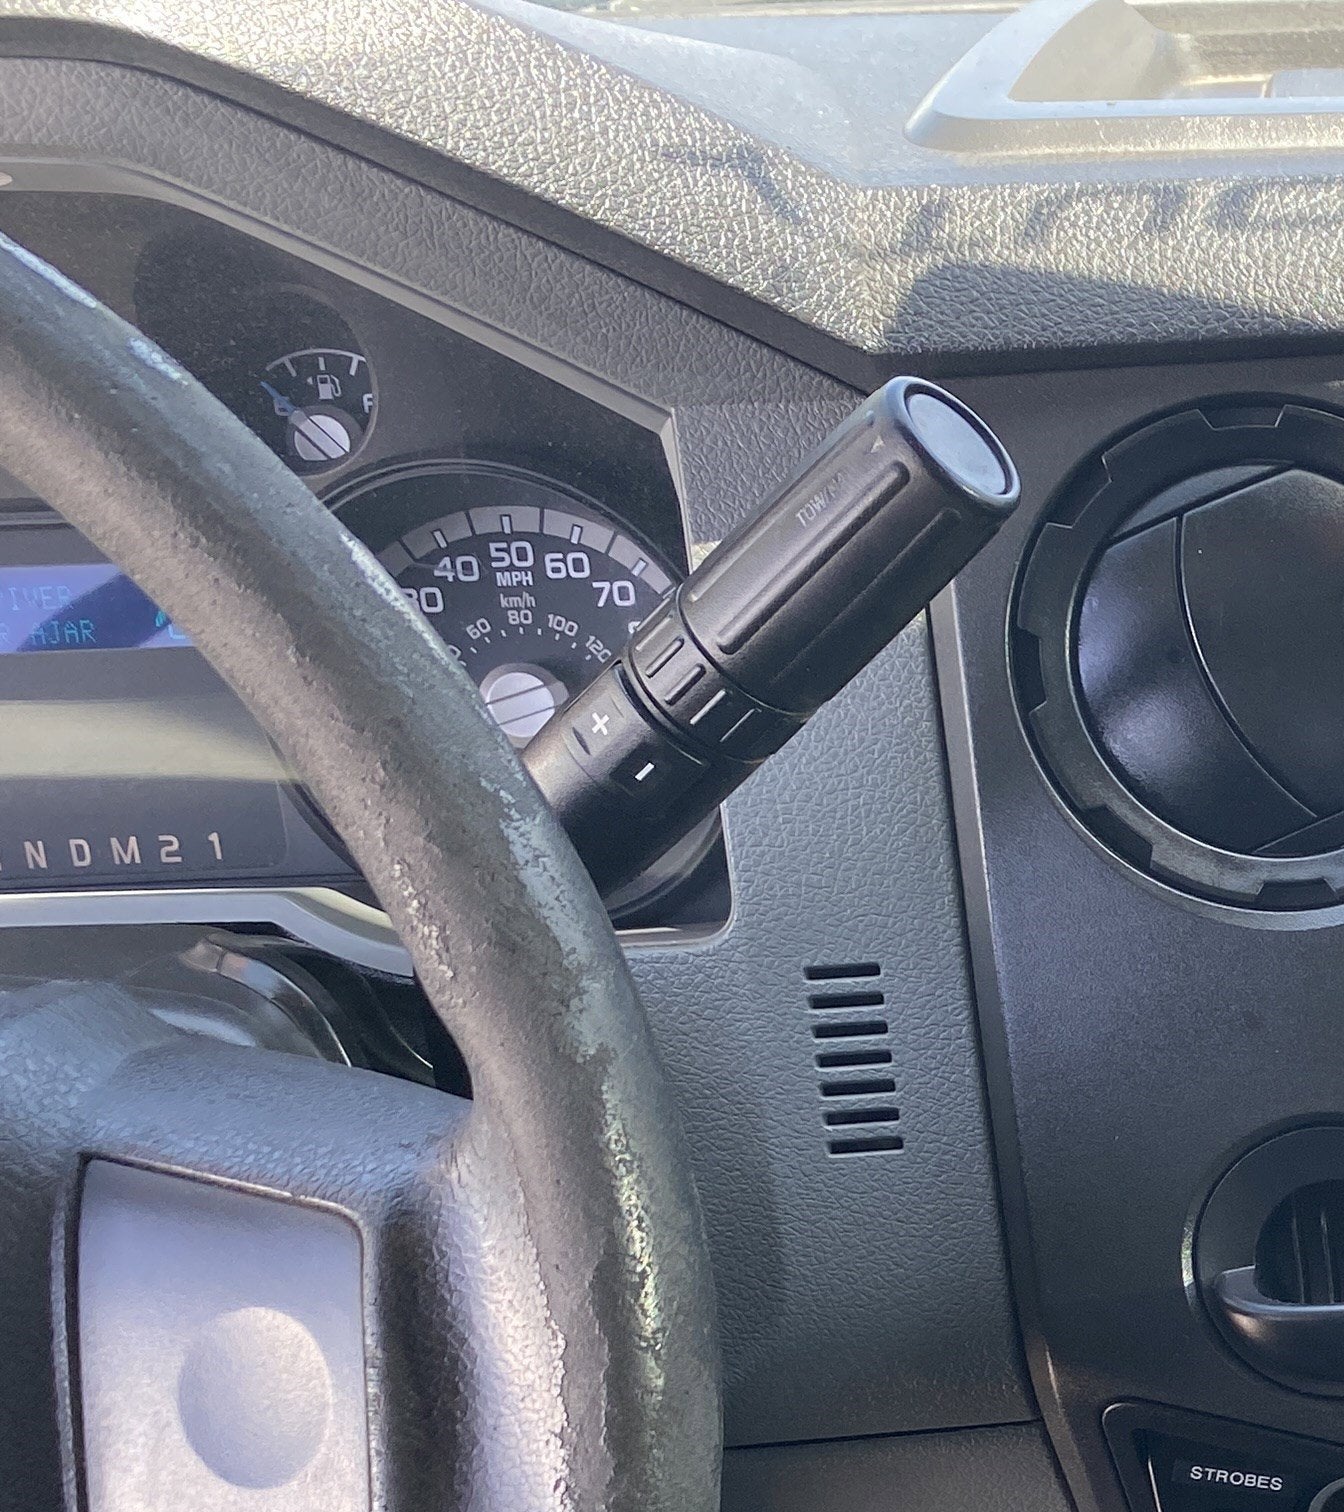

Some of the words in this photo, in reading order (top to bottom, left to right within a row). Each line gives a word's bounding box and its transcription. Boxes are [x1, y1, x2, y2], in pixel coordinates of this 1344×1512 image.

[362, 393, 373, 414] F
[489, 541, 534, 568] 50
[544, 552, 590, 579] 60
[433, 555, 480, 582] 40
[496, 572, 534, 587] MPH
[500, 592, 536, 608] km/h
[592, 580, 636, 607] 70
[466, 618, 492, 640] 60
[508, 610, 533, 625] 80
[547, 613, 579, 637] 100
[31, 619, 96, 645] AJAR
[585, 635, 612, 663] 120
[1190, 1466, 1283, 1491] STROBES
